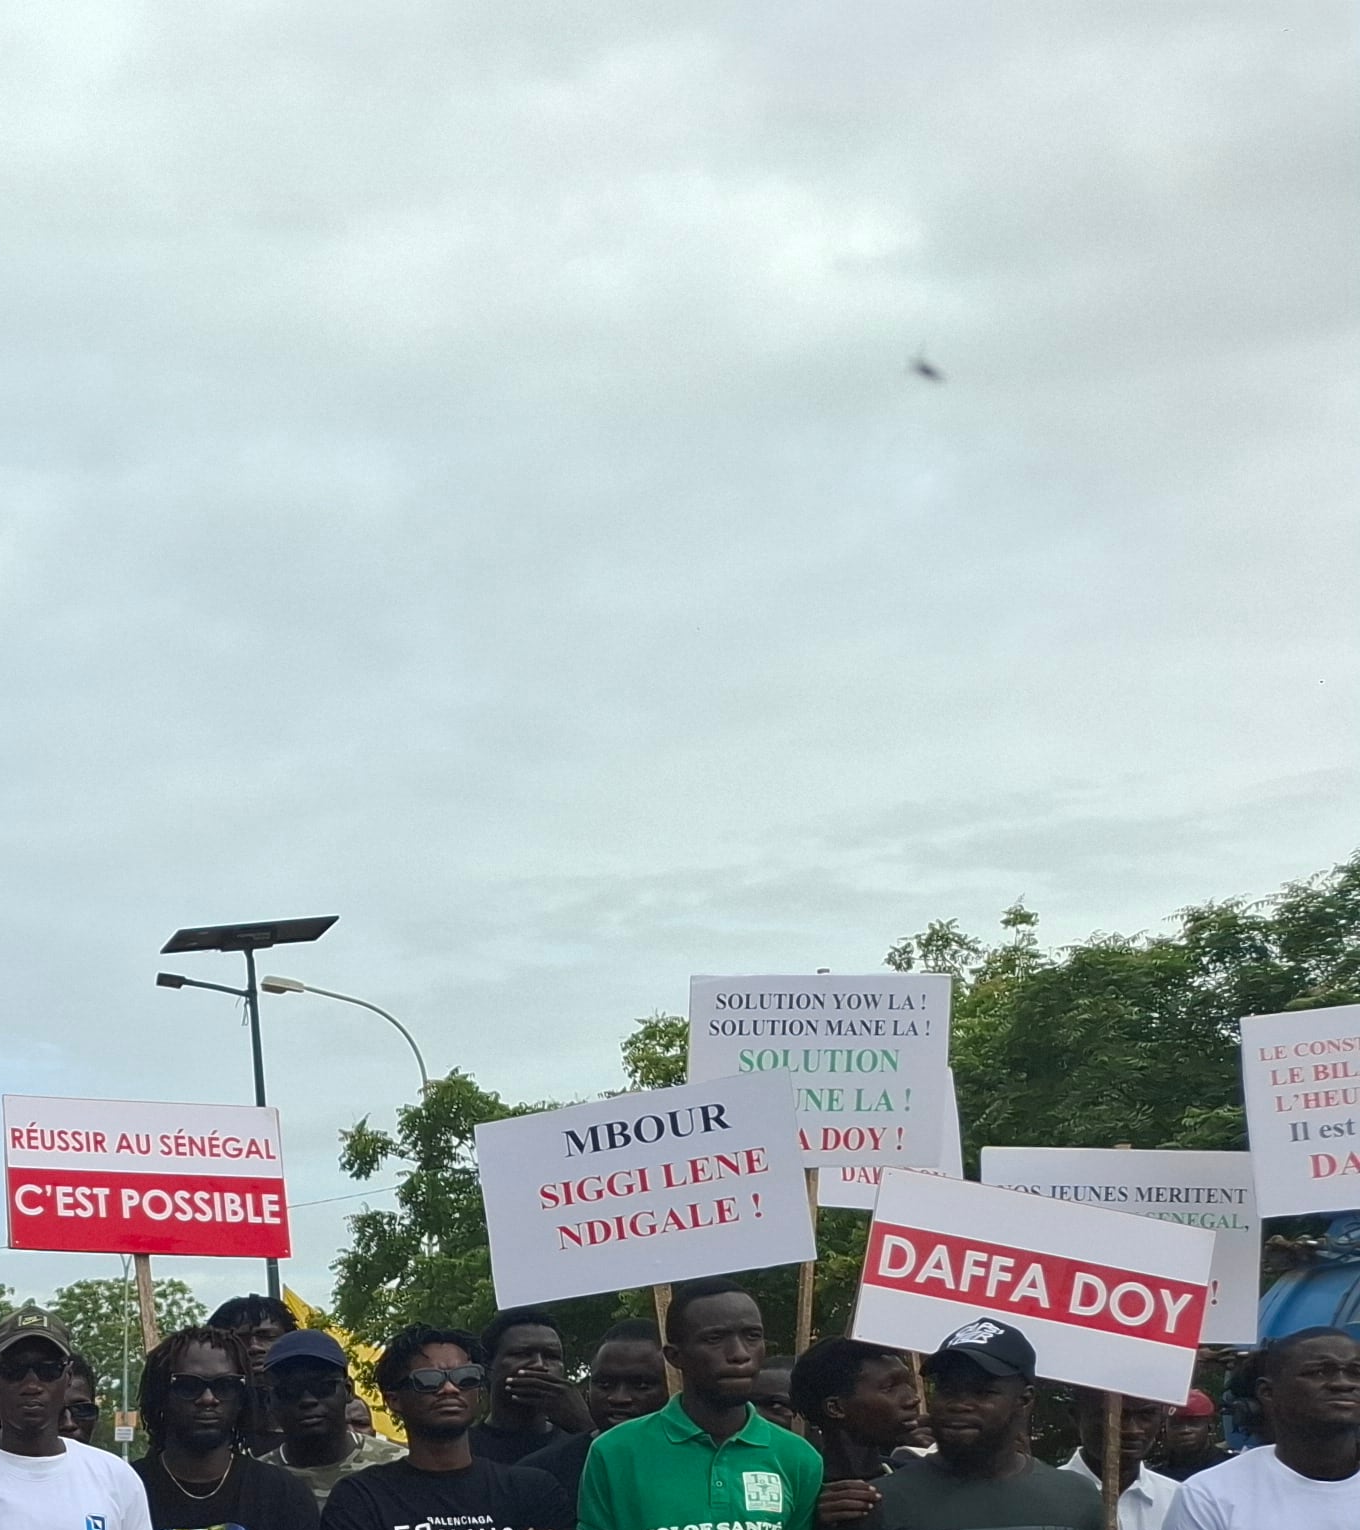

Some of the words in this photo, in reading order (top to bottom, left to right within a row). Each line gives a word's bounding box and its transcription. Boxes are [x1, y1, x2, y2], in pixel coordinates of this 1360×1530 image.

[716, 993, 826, 1010] SOLUTION
[832, 993, 883, 1010] YOW
[888, 993, 915, 1010] LA
[921, 994, 927, 1010] !
[709, 1019, 819, 1036] SOLUTION
[824, 1019, 886, 1036] MANE
[892, 1020, 919, 1036] LA
[925, 1020, 931, 1036] !
[739, 1049, 900, 1073] SOLUTION
[1259, 1045, 1287, 1061] LE
[1270, 1066, 1305, 1086] LE
[1313, 1061, 1360, 1081] BIL
[855, 1088, 894, 1112] LA
[905, 1088, 911, 1112] !
[11, 1121, 107, 1154] RÉUSSIR
[116, 1132, 150, 1155] AU
[160, 1128, 276, 1160] SÉNÉGAL
[563, 1103, 731, 1158] MBOUR
[820, 1127, 887, 1151] DOY
[896, 1127, 904, 1151] !
[1319, 1118, 1356, 1139] est
[539, 1168, 650, 1211] SIGGI
[661, 1147, 769, 1190] LENE
[15, 1184, 110, 1218] C'EST
[122, 1189, 281, 1224] POSSIBLE
[1135, 1186, 1248, 1204] MERITENT
[556, 1197, 740, 1251] NDIGALE
[751, 1193, 764, 1219] !
[877, 1233, 1050, 1309] DAFFA
[1069, 1271, 1194, 1334] DOY
